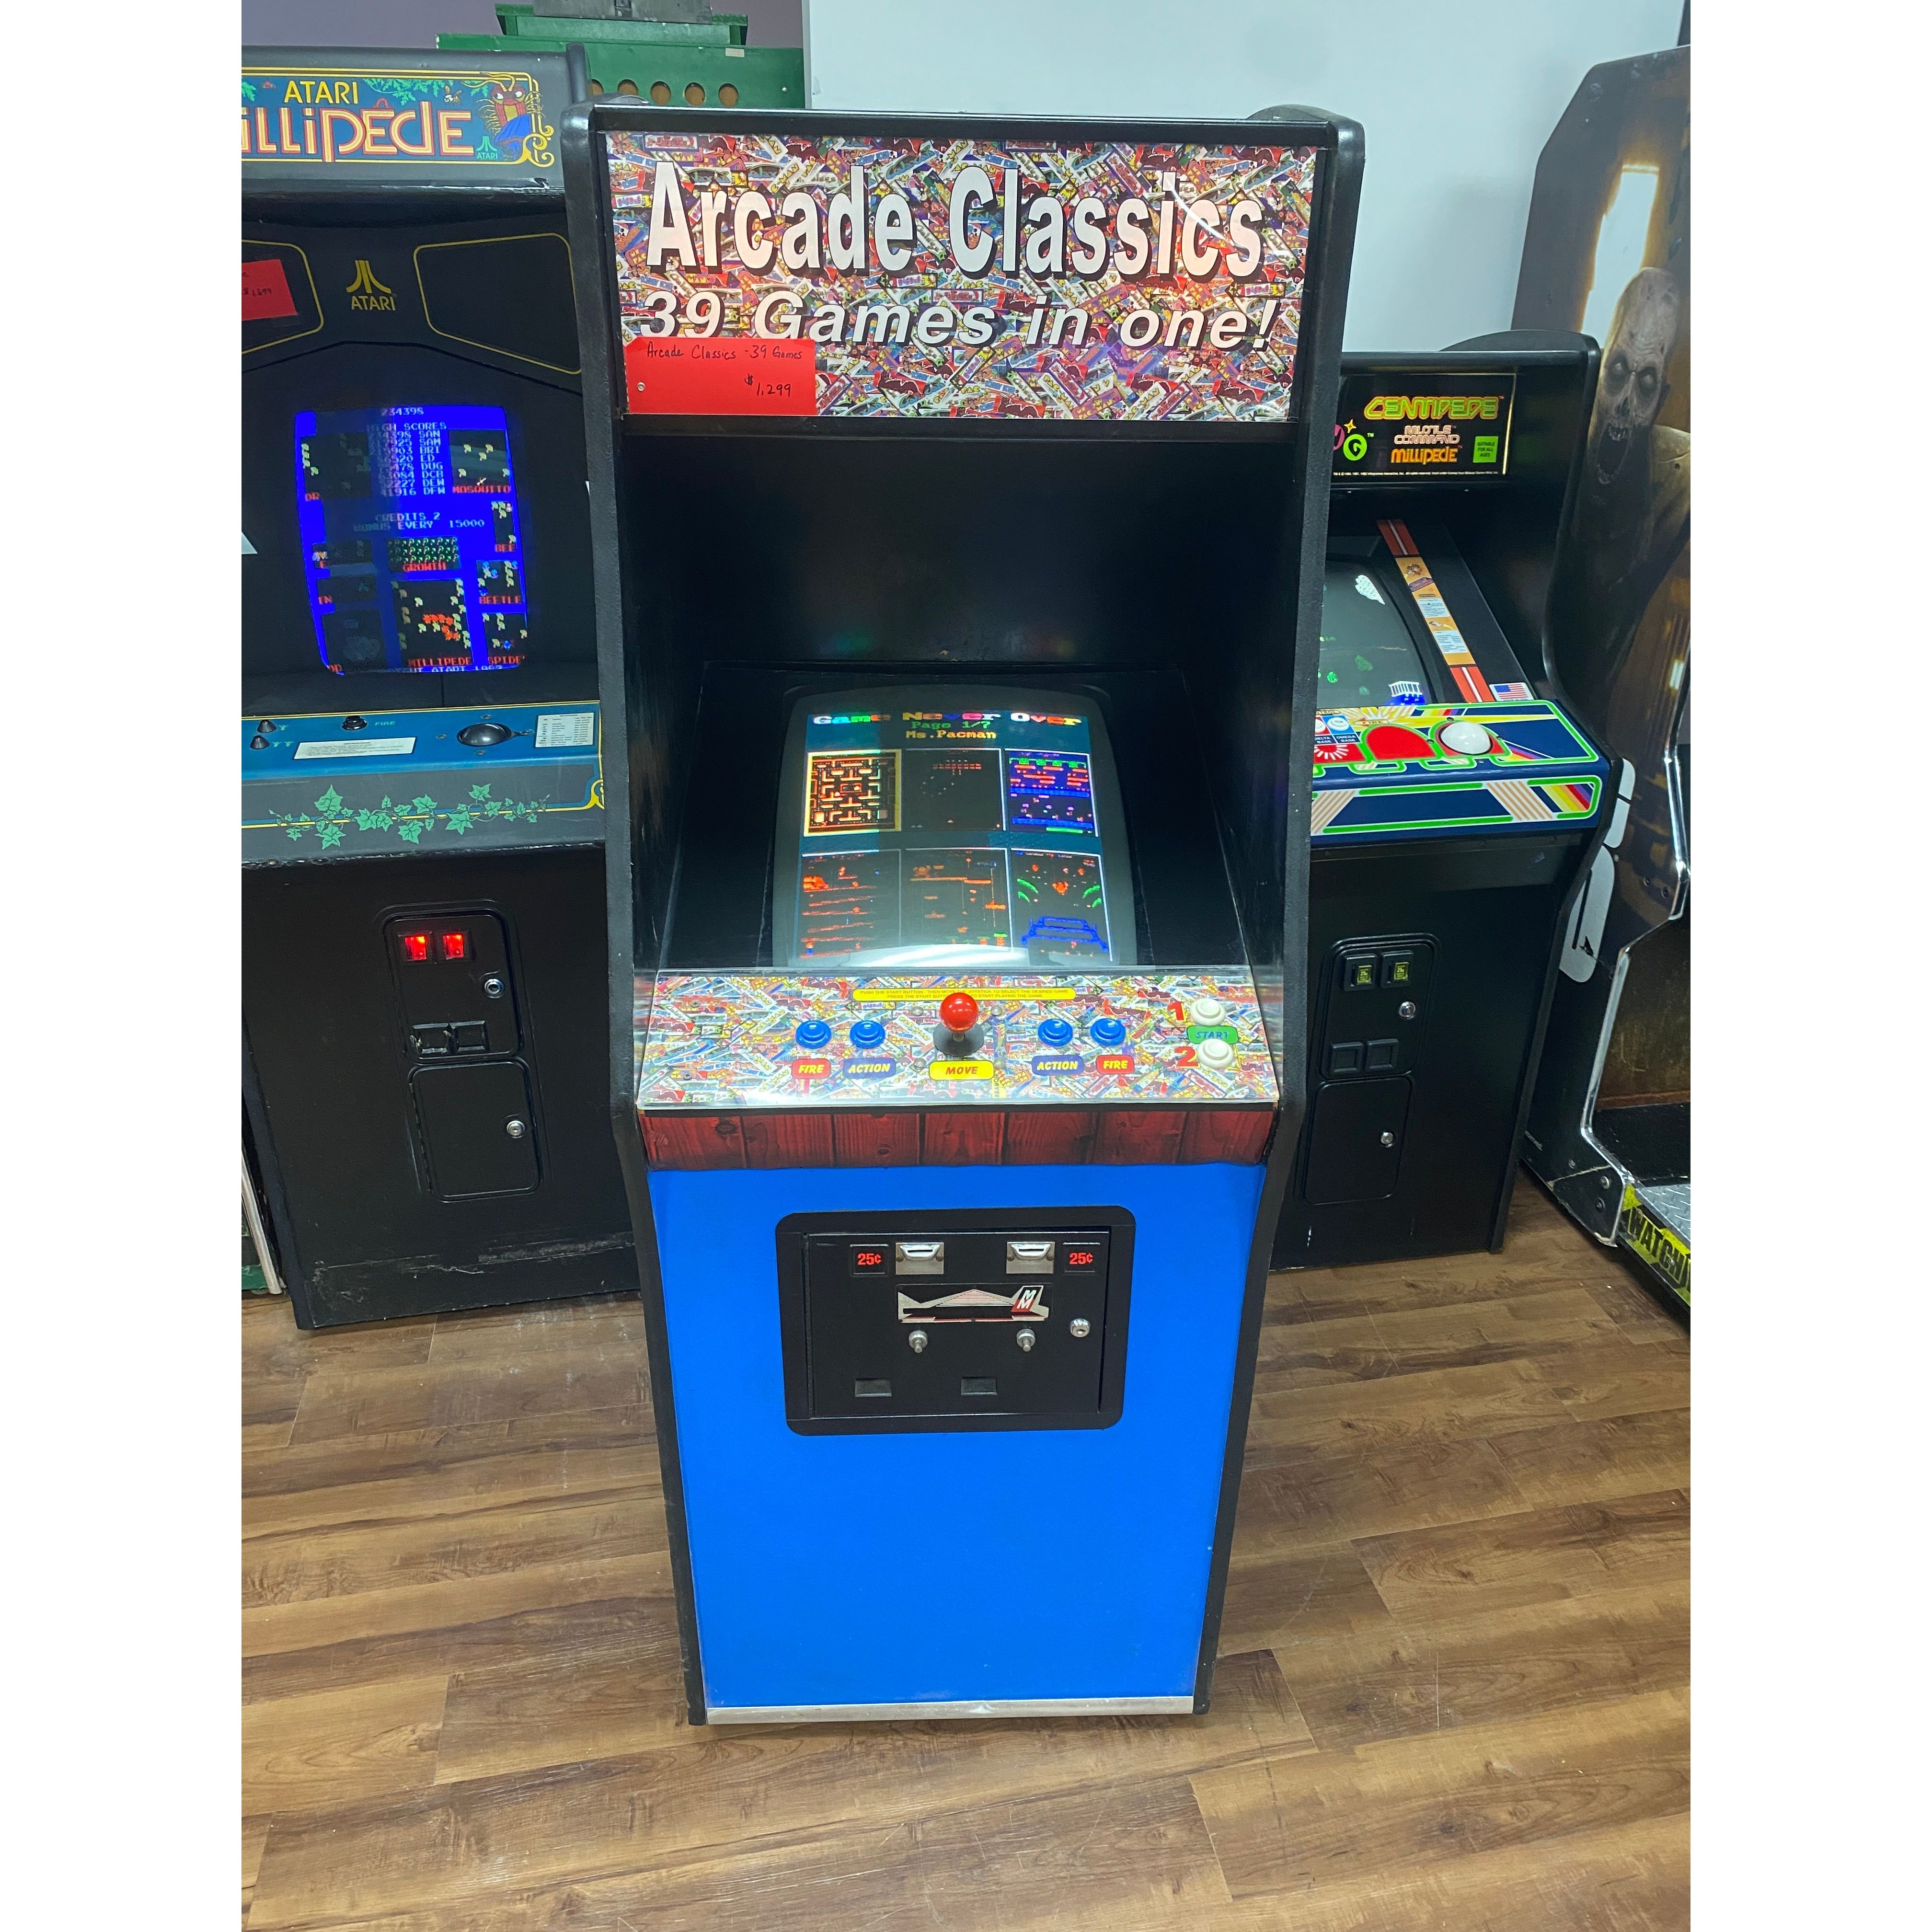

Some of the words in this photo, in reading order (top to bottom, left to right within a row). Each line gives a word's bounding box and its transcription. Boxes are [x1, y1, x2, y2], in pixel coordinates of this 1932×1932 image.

[284, 80, 358, 104] ATARI
[646, 161, 914, 272] Arcade
[949, 166, 1264, 276] Classics
[351, 295, 396, 311] ATARI
[640, 290, 721, 338] 39
[754, 290, 995, 345] Games
[1026, 295, 1089, 345] in
[1120, 299, 1278, 349] one!
[647, 341, 684, 357] Arcade
[691, 344, 736, 360] Classics
[772, 346, 803, 360] Games
[1364, 396, 1499, 420] CENTIPEDE
[403, 422, 447, 431] SCORES
[1404, 425, 1452, 435] MISSILE
[419, 430, 440, 438] SAN
[1394, 434, 1460, 445] COMMAND
[419, 437, 441, 446] SAM
[422, 461, 443, 470] DUG
[423, 478, 445, 487] DEW
[424, 486, 446, 495] DFW
[375, 512, 426, 522] CREDITS
[433, 512, 441, 520] 2
[397, 520, 434, 530] EVERY
[449, 519, 485, 528] 15000
[402, 562, 447, 572] GROWTH
[479, 595, 522, 605] BEETLE
[813, 713, 892, 725] Game
[902, 711, 1002, 722] Never
[1010, 712, 1082, 726] Over
[911, 720, 952, 729] Page
[962, 720, 991, 729] 1/7
[1168, 1001, 1188, 1023] 1
[1196, 1030, 1231, 1040] START
[1173, 1046, 1201, 1069] 2
[798, 1064, 825, 1074] FIRE
[848, 1063, 891, 1074] ACTION
[945, 1066, 978, 1075] MOVE
[1036, 1060, 1078, 1070] ACTION
[1103, 1060, 1128, 1070] FIRE
[857, 1253, 882, 1266] 25¢
[1069, 1252, 1093, 1266] 25¢
